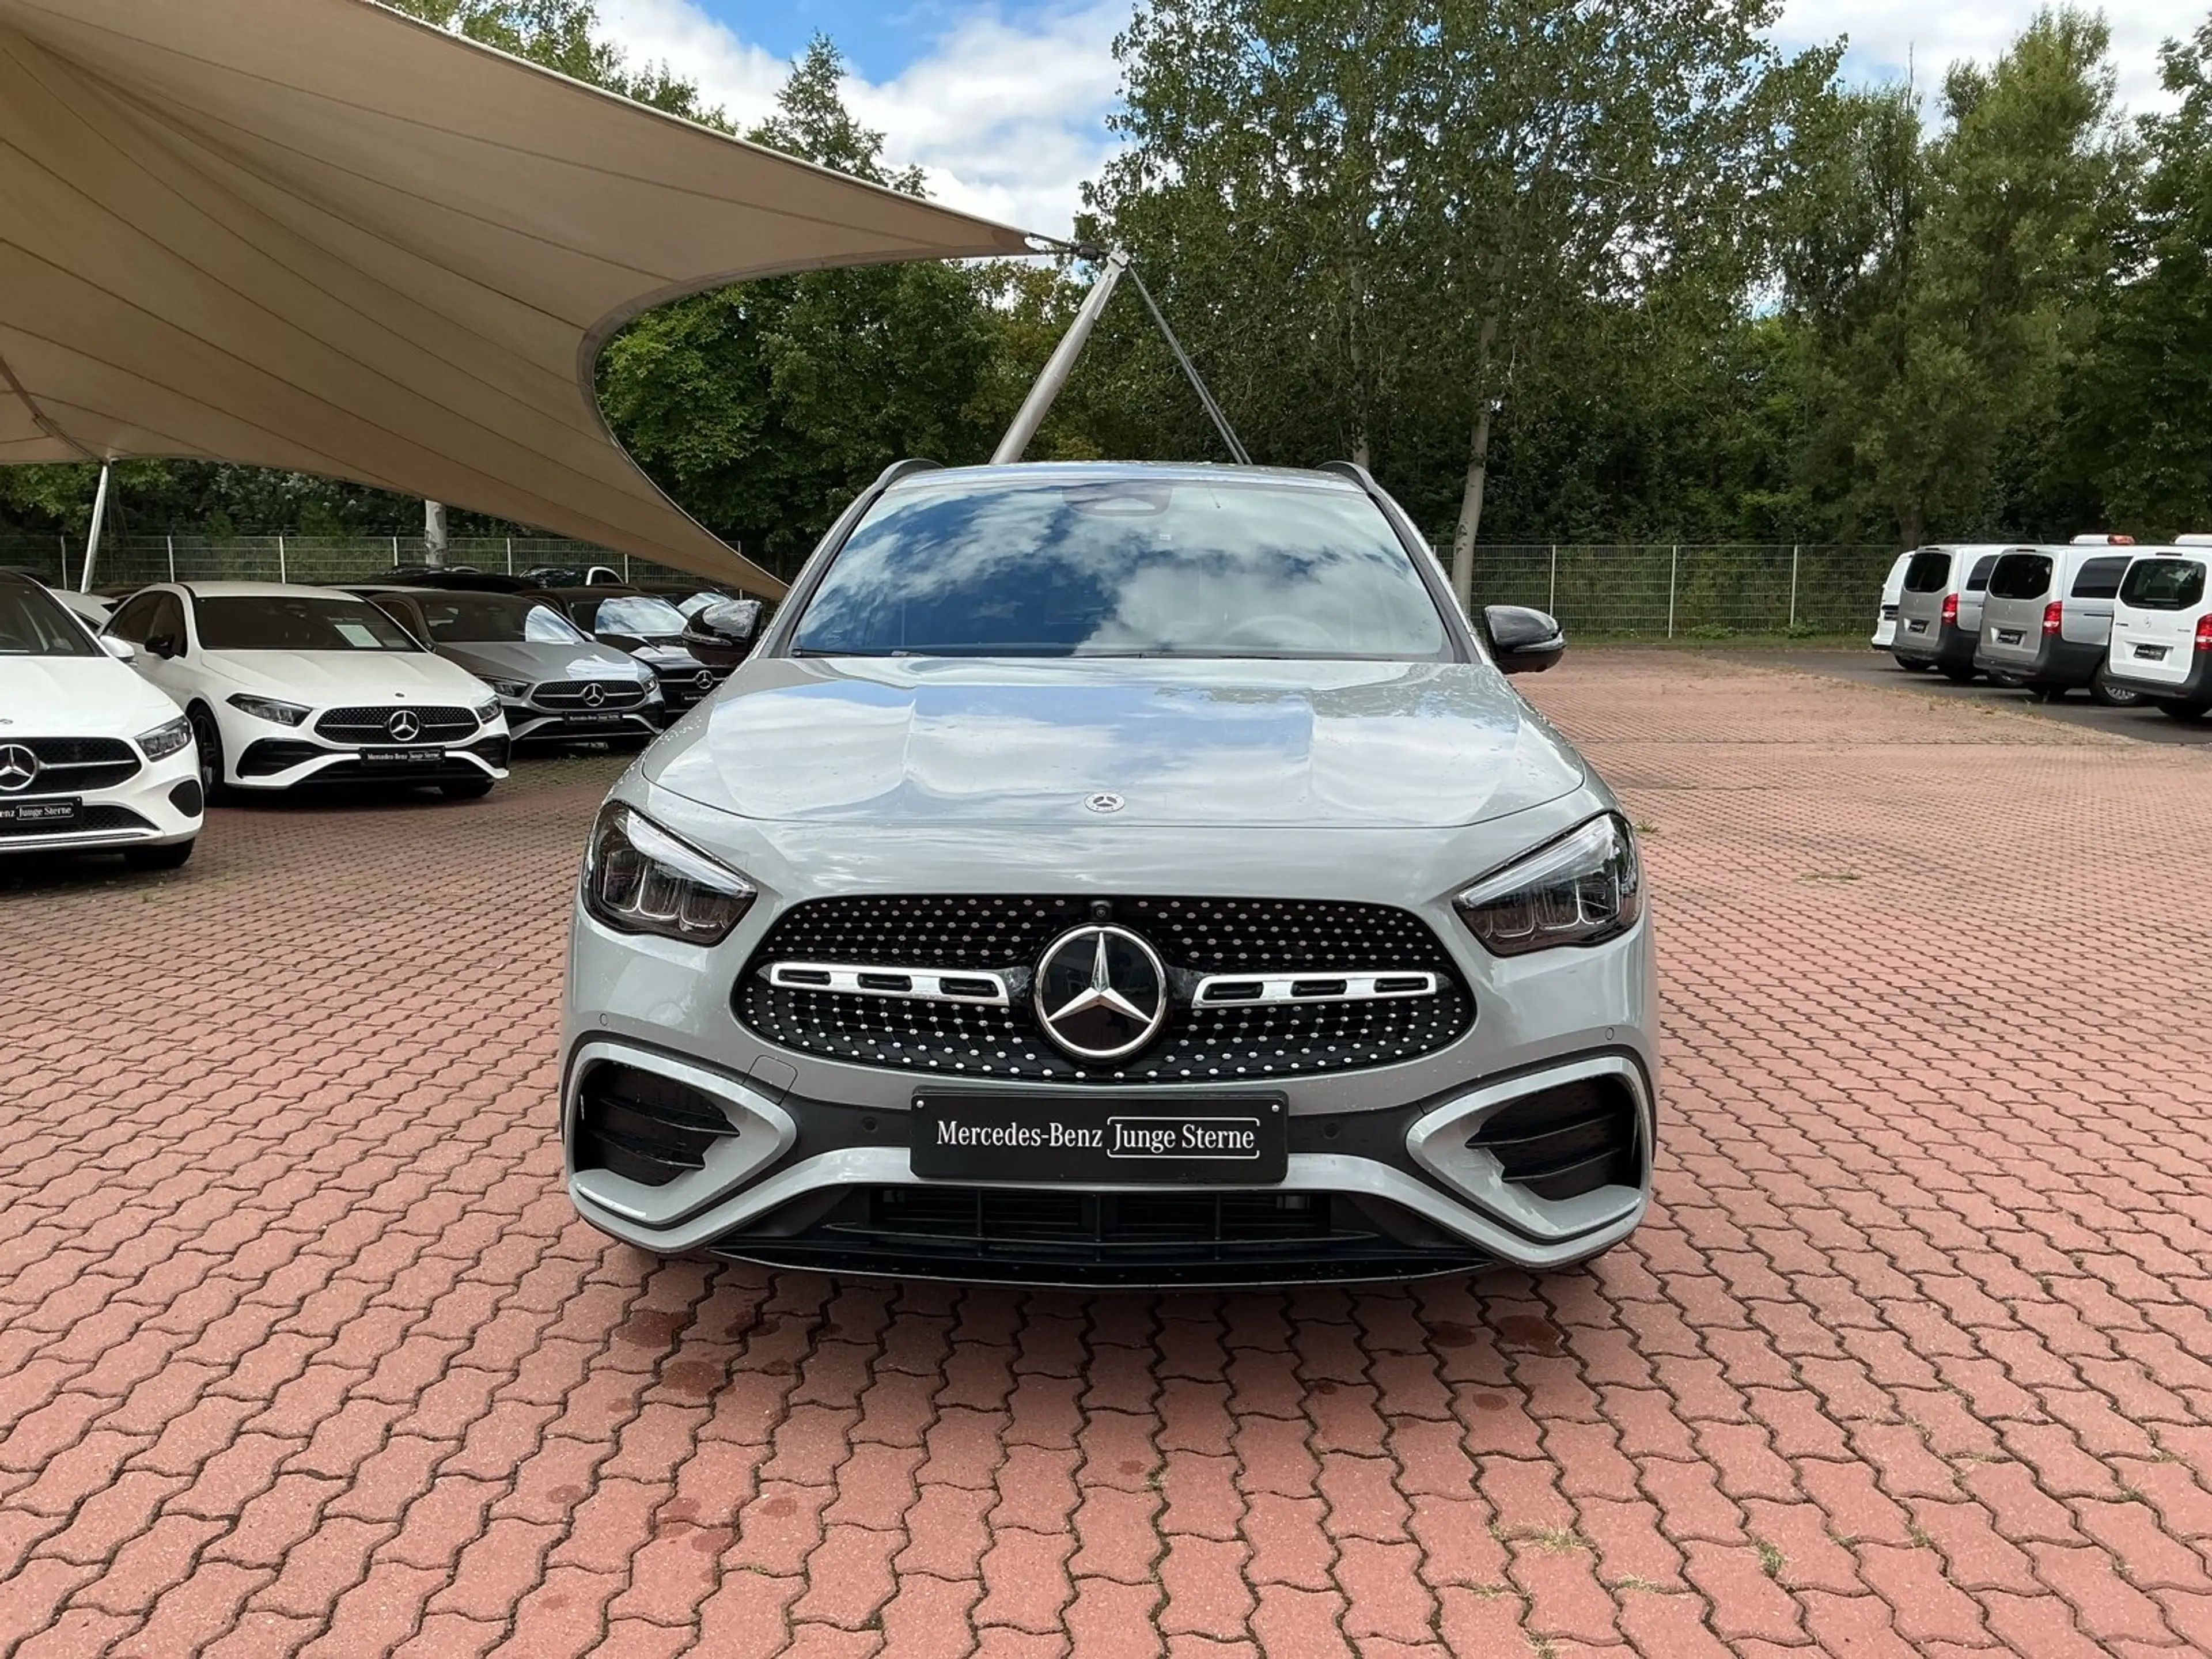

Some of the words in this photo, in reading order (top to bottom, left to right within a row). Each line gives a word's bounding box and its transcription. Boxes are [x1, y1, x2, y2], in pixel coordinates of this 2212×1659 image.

[936, 1120, 1103, 1147] Mercedes-Benz
[1113, 1124, 1176, 1153] Junge
[1182, 1124, 1255, 1148] Sterne
